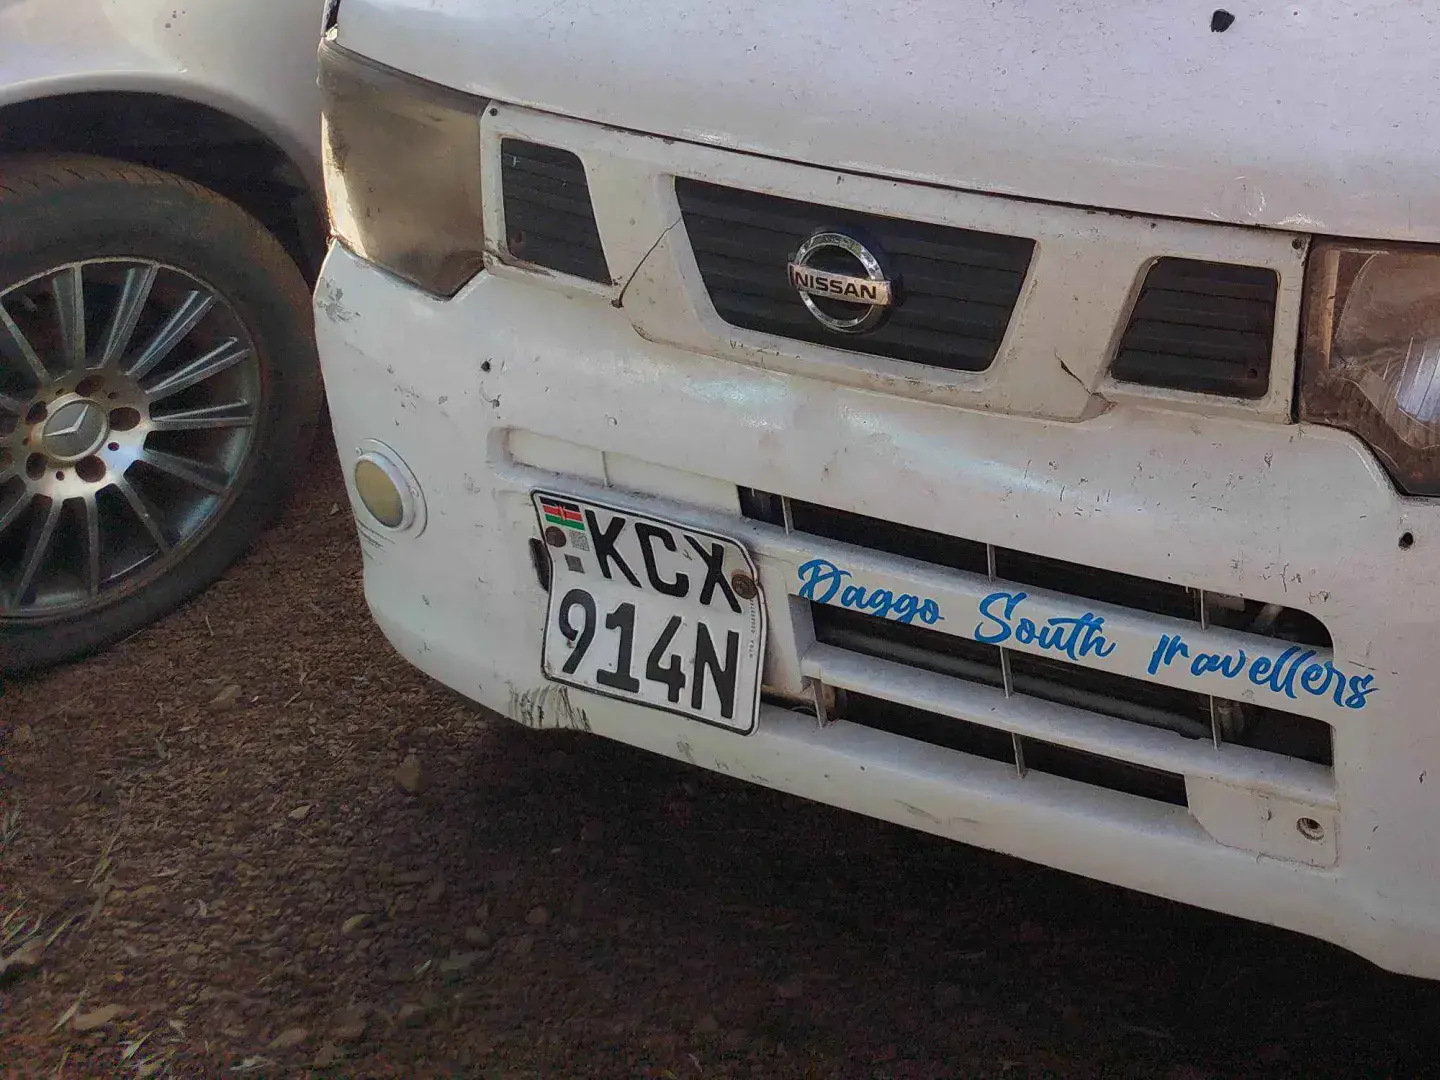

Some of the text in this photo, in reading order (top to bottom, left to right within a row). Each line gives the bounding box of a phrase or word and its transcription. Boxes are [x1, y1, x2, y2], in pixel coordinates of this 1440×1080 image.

[795, 272, 877, 300] NISSAN
[584, 509, 743, 614] KCX
[558, 588, 740, 720] 914N
[973, 591, 1117, 661] South
